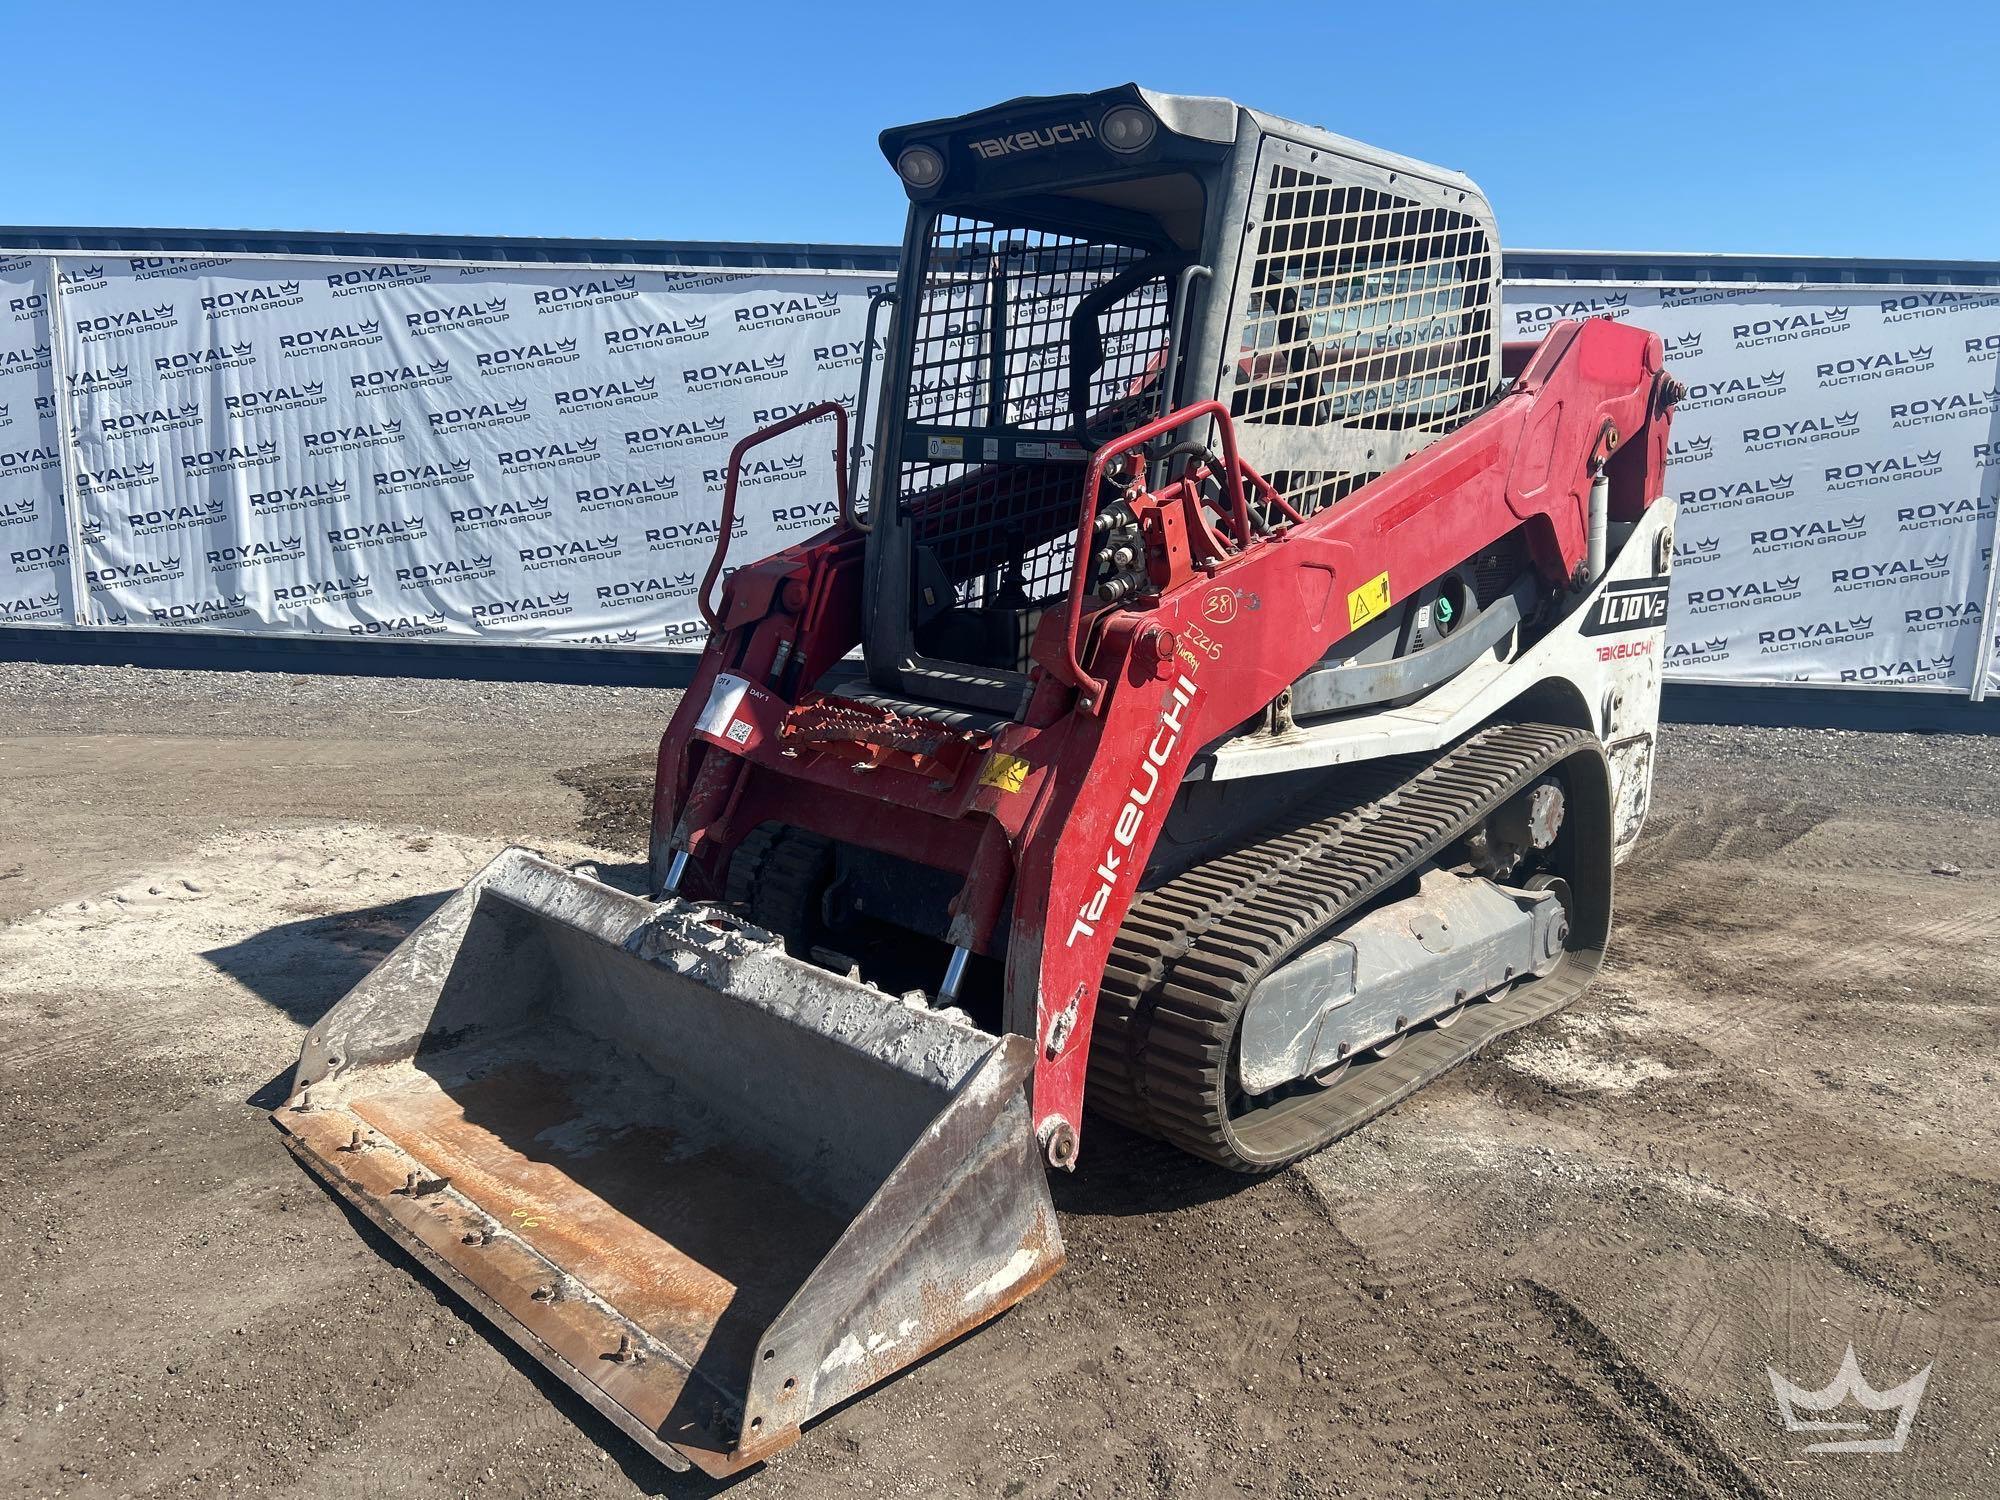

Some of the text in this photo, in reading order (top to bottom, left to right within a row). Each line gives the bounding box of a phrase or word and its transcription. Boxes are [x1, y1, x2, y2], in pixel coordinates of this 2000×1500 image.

[66, 281, 108, 295] GROUP
[327, 264, 408, 289] ROYAL
[200, 286, 280, 311] ROYAL
[534, 280, 616, 305] ROYAL
[538, 290, 639, 315] AUCTION GROUP
[205, 296, 303, 320] AUCTION GROUP
[406, 303, 487, 327] ROYAL
[734, 297, 817, 322] ROYAL
[738, 308, 841, 332] AUCTION GROUP
[1516, 298, 1605, 324] ROYAL
[1883, 298, 2000, 324] AUCTION GROUP
[76, 309, 155, 334] ROYAL
[81, 319, 178, 344] AUCTION GROUP
[410, 313, 510, 337] AUCTION GROUP
[604, 320, 686, 345] ROYAL
[1733, 313, 1825, 339] ROYAL
[279, 325, 360, 349] ROYAL
[284, 335, 383, 359] AUCTION GROUP
[608, 331, 709, 355] AUCTION GROUP
[1735, 323, 1850, 349] AUCTION GROUP
[155, 347, 234, 371] ROYAL
[476, 343, 557, 367] ROYAL
[480, 353, 580, 377] AUCTION GROUP
[1816, 352, 1909, 378] ROYAL
[160, 357, 256, 381] AUCTION GROUP
[350, 365, 430, 389] ROYAL
[682, 359, 765, 384] ROYAL
[1819, 362, 1935, 388] AUCTION GROUP
[355, 375, 453, 398] AUCTION GROUP
[554, 381, 635, 405] ROYAL
[686, 369, 788, 394] AUCTION GROUP
[224, 386, 304, 410] ROYAL
[229, 396, 327, 419] AUCTION GROUP
[558, 391, 658, 415] AUCTION GROUP
[1673, 386, 1787, 413] AUCTION GROUP
[1890, 393, 1983, 419] ROYAL
[101, 408, 181, 432] ROYAL
[428, 403, 508, 427] ROYAL
[432, 413, 531, 436] AUCTION GROUP
[1892, 412, 1955, 429] AUCTION
[107, 418, 203, 441] AUCTION GROUP
[303, 424, 383, 447] ROYAL
[624, 421, 706, 445] ROYAL
[1743, 417, 1835, 443] ROYAL
[1744, 427, 1860, 453] AUCTION GROUP
[308, 434, 405, 457] AUCTION GROUP
[497, 442, 578, 466] ROYAL
[628, 431, 729, 455] AUCTION GROUP
[180, 445, 258, 468] ROYAL
[186, 455, 280, 478] AUCTION GROUP
[502, 453, 601, 475] AUCTION GROUP
[373, 463, 452, 486] ROYAL
[763, 470, 807, 484] GROUP
[1825, 456, 1917, 482] ROYAL
[1826, 466, 1942, 492] AUCTION GROUP
[250, 484, 328, 507] ROYAL
[377, 473, 474, 496] AUCTION GROUP
[575, 480, 656, 504] ROYAL
[1679, 480, 1769, 505] ROYAL
[254, 494, 351, 516] AUCTION GROUP
[450, 501, 529, 524] ROYAL
[580, 490, 679, 513] AUCTION GROUP
[1681, 490, 1794, 515] AUCTION GROUP
[1897, 497, 1991, 522] ROYAL
[128, 504, 206, 528] ROYAL
[134, 514, 229, 537] AUCTION GROUP
[454, 511, 552, 533] AUCTION GROUP
[1899, 516, 1963, 532] AUCTION
[327, 521, 405, 544] ROYAL
[331, 531, 427, 553] AUCTION GROUP
[1750, 520, 1841, 545] ROYAL
[1752, 530, 1867, 555] AUCTION GROUP
[204, 541, 282, 564] ROYAL
[209, 551, 305, 573] AUCTION GROUP
[519, 540, 599, 562] ROYAL
[523, 550, 622, 572] AUCTION GROUP
[85, 562, 162, 584] ROYAL
[88, 571, 184, 593] AUCTION GROUP
[395, 559, 473, 582] ROYAL
[400, 569, 496, 591] AUCTION GROUP
[1831, 559, 1924, 583] ROYAL
[1833, 569, 1950, 593] AUCTION GROUP
[273, 579, 351, 601] ROYAL
[278, 588, 373, 610] AUCTION GROUP
[596, 577, 675, 599] ROYAL
[600, 587, 697, 609] AUCTION GROUP
[1687, 581, 1777, 605] ROYAL
[471, 597, 550, 618] ROYAL
[1204, 594, 1233, 615] 381
[1689, 591, 1801, 615] AUCTION GROUP
[475, 606, 572, 628] AUCTION GROUP
[1758, 621, 1849, 645] ROYAL
[1760, 631, 1874, 655] AUCTION GROUP
[1906, 670, 1956, 684] GROUP
[749, 688, 765, 699] DAY
